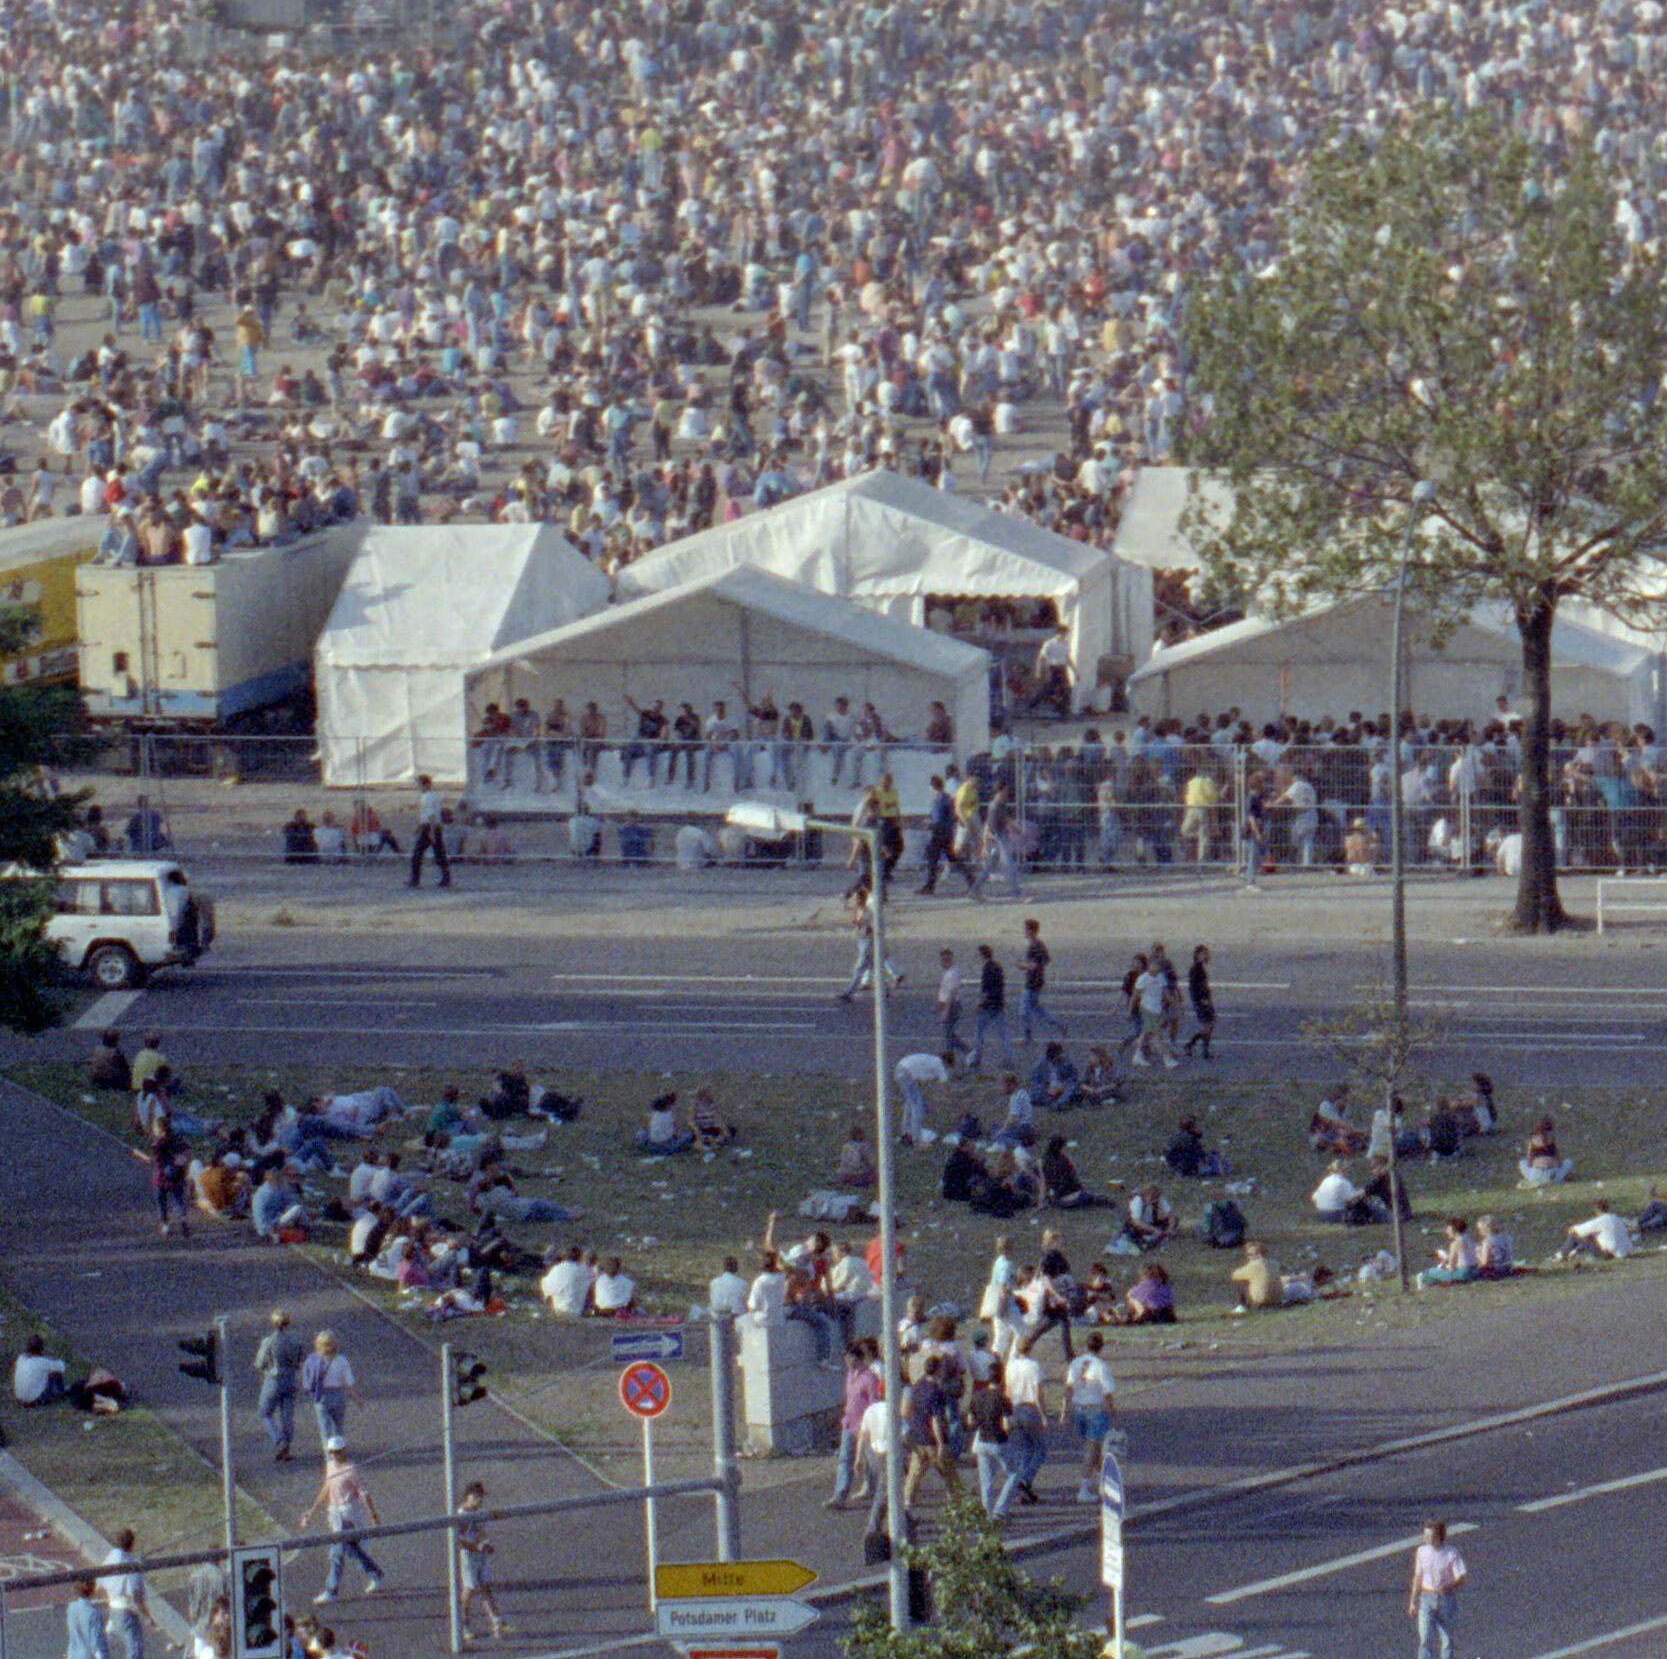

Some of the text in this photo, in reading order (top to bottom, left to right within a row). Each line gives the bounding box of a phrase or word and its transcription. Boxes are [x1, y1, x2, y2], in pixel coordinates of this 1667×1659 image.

[701, 1571, 745, 1587] Mitte
[670, 1608, 776, 1626] Potsdamer Platz
